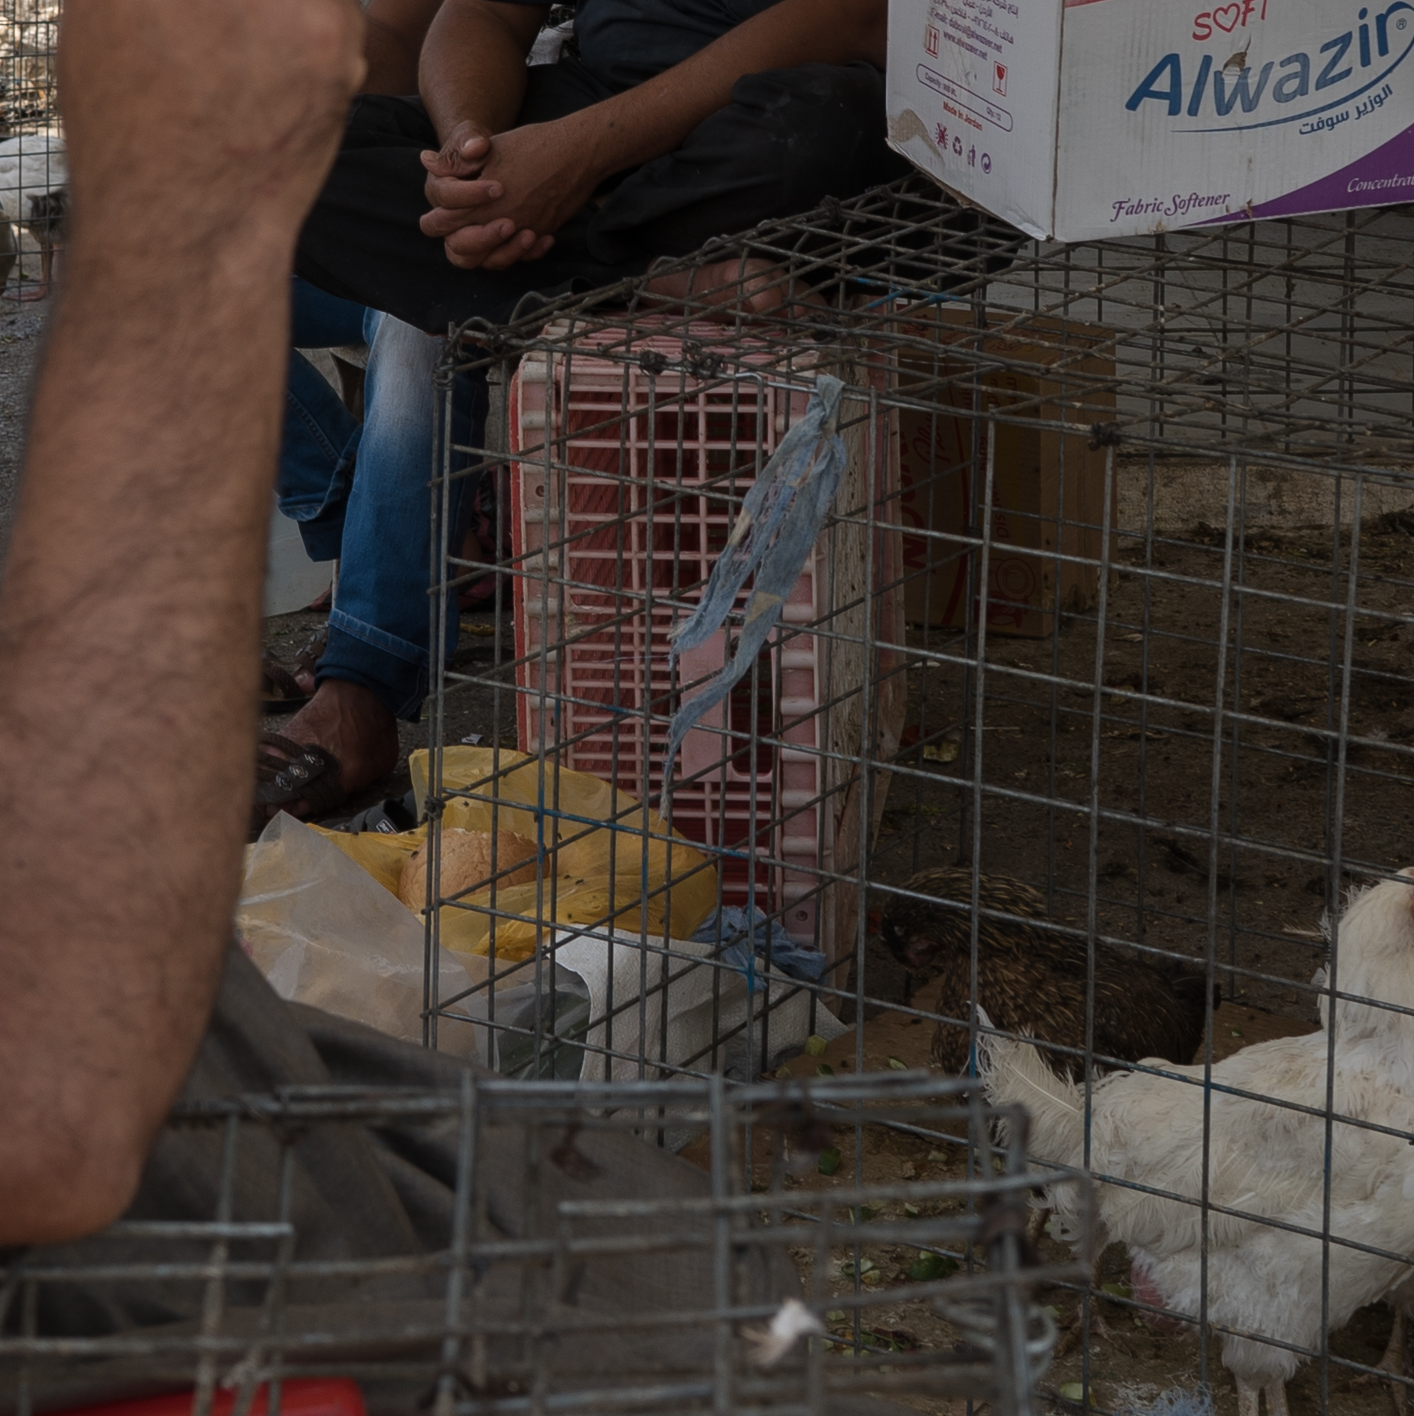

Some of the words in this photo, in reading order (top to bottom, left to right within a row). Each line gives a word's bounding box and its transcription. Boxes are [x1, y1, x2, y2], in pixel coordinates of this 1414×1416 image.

[1353, 84, 1394, 121] الوزير
[1298, 110, 1350, 136] سوفت
[1110, 196, 1164, 221] Fabric
[1164, 192, 1232, 217] Softener
